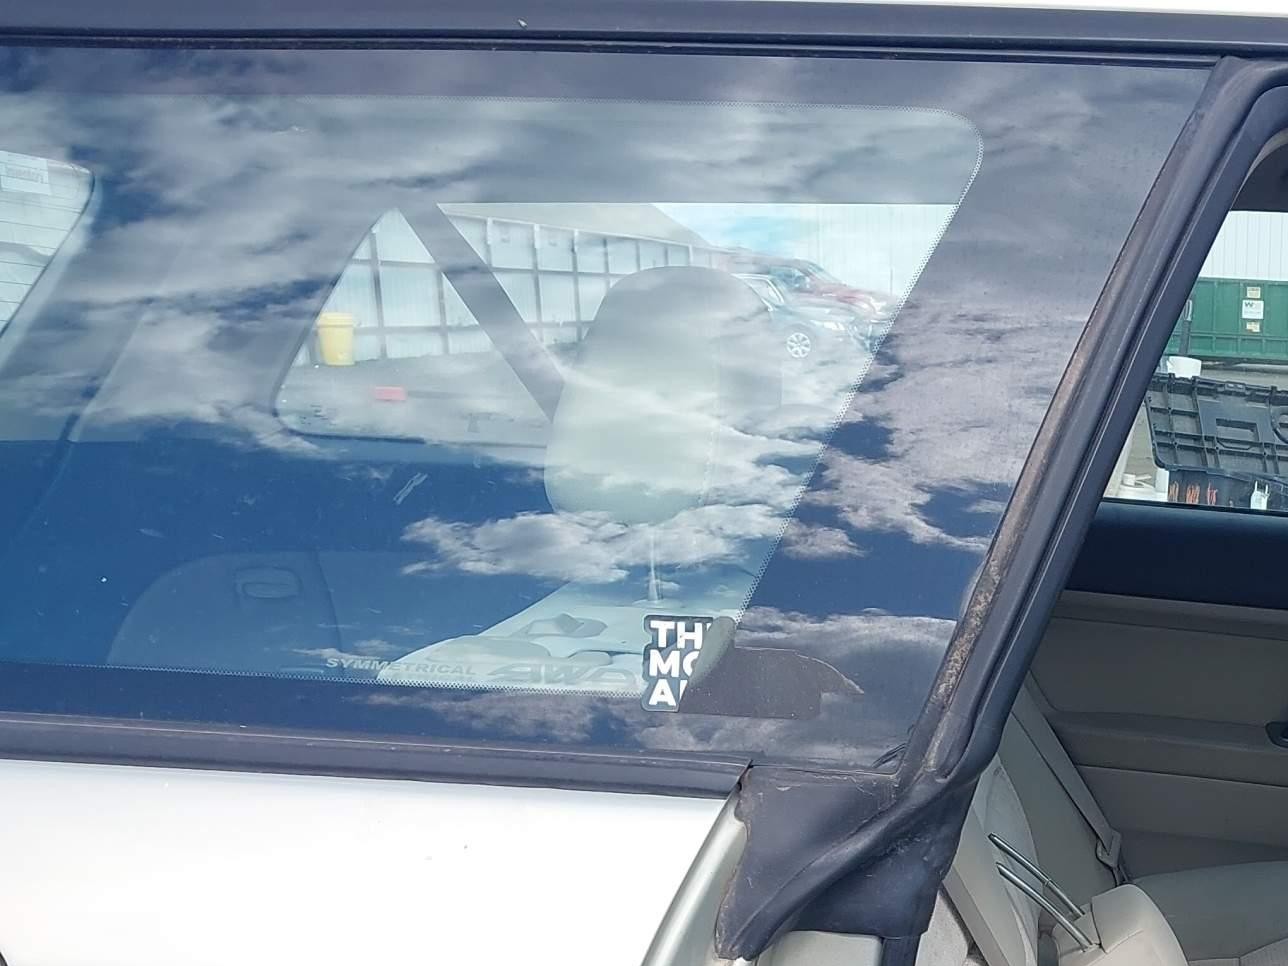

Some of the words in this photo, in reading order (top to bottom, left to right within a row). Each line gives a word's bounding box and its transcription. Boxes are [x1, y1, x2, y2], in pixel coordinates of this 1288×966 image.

[650, 620, 712, 650] TH
[326, 657, 476, 675] SYMMETRICAL
[487, 662, 636, 685] AWD
